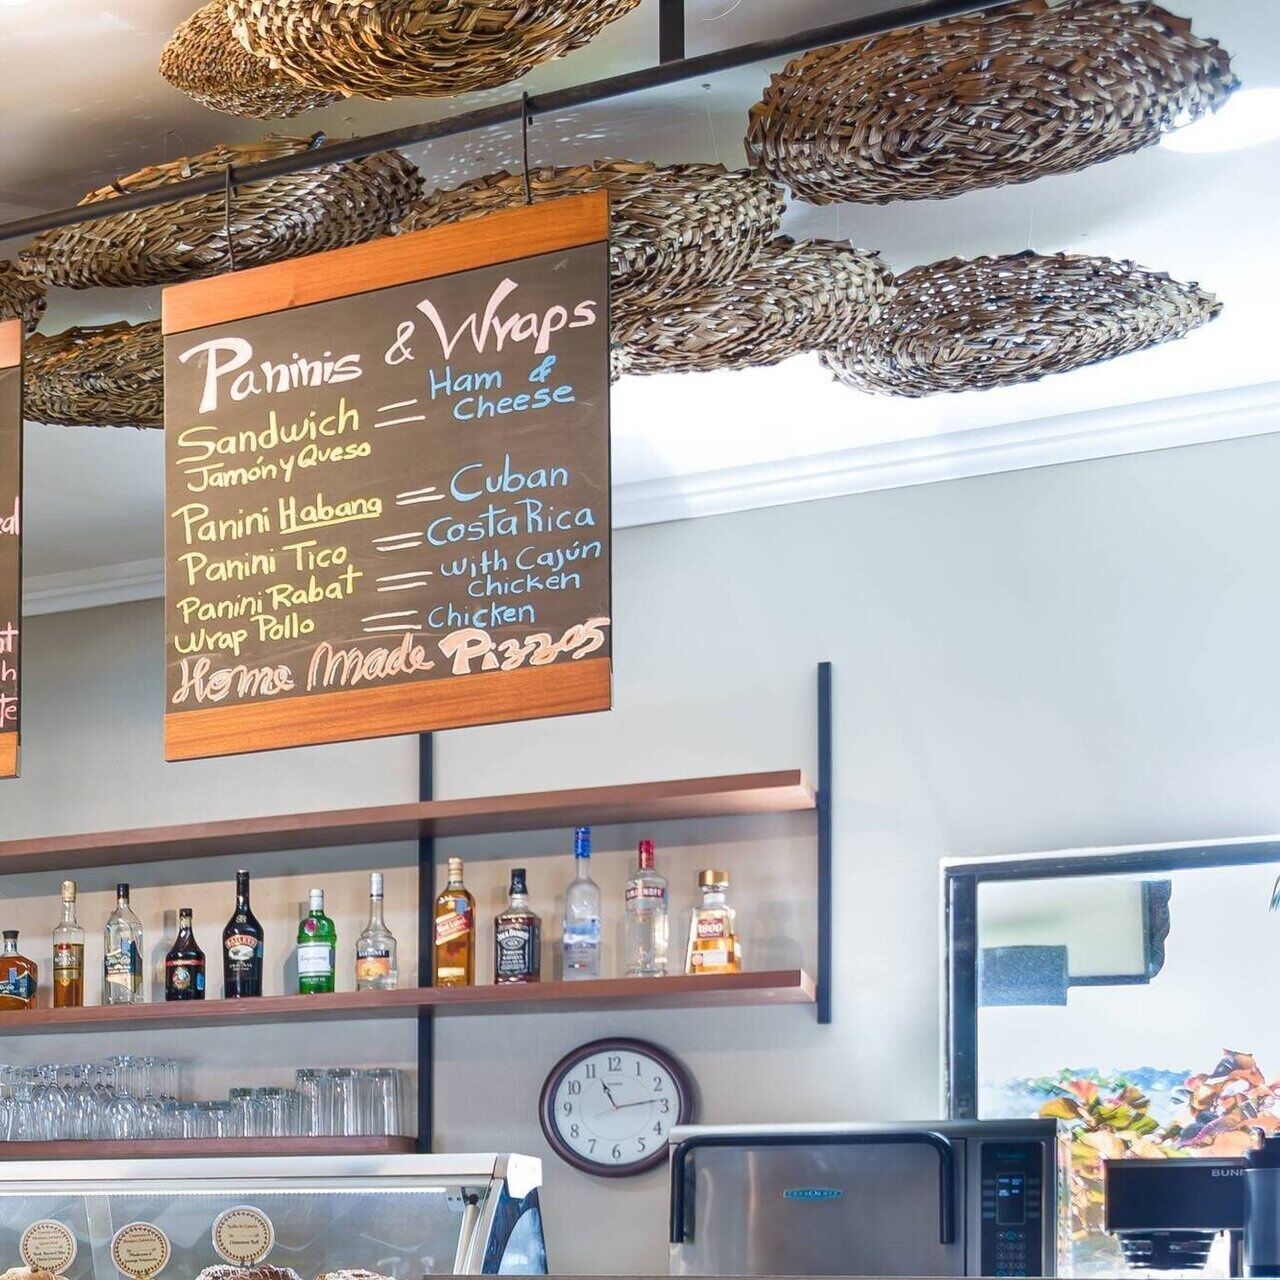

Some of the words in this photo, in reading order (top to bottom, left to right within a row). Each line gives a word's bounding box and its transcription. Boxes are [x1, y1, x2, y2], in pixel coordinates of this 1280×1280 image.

[178, 337, 363, 413] Paninis
[383, 321, 416, 366] &
[416, 277, 597, 360] Wraps
[428, 367, 503, 399] Ham
[452, 382, 575, 421] Cheese
[176, 398, 359, 464] Sandwich
[184, 456, 277, 492] Jamón
[280, 455, 295, 482] y
[297, 441, 372, 468] Queso
[450, 454, 569, 501] Cuban
[171, 503, 271, 544] Panini
[278, 493, 383, 531] Habana
[426, 504, 517, 546] Costa
[514, 498, 596, 536] Rica
[178, 548, 276, 585] Panini
[282, 540, 348, 572] Tico
[515, 537, 602, 573] Cajún
[177, 594, 263, 624] Panini
[265, 564, 364, 611] Rabat
[468, 573, 580, 598] Chicken
[249, 613, 315, 644] Pollo
[428, 601, 536, 629] Chicken
[171, 656, 295, 704] Home
[306, 633, 435, 691] Made
[438, 617, 611, 675] Pizzas
[585, 1064, 596, 1078] 11
[608, 1056, 622, 1072] 12
[635, 1061, 641, 1076] 1
[568, 1080, 581, 1095] 10
[653, 1076, 662, 1091] 2
[563, 1102, 572, 1116] 9
[660, 1098, 669, 1113] 3
[570, 1123, 579, 1138] 8
[653, 1121, 662, 1135] 4
[588, 1139, 597, 1154] 7
[612, 1144, 621, 1159] 6
[637, 1138, 645, 1152] 5
